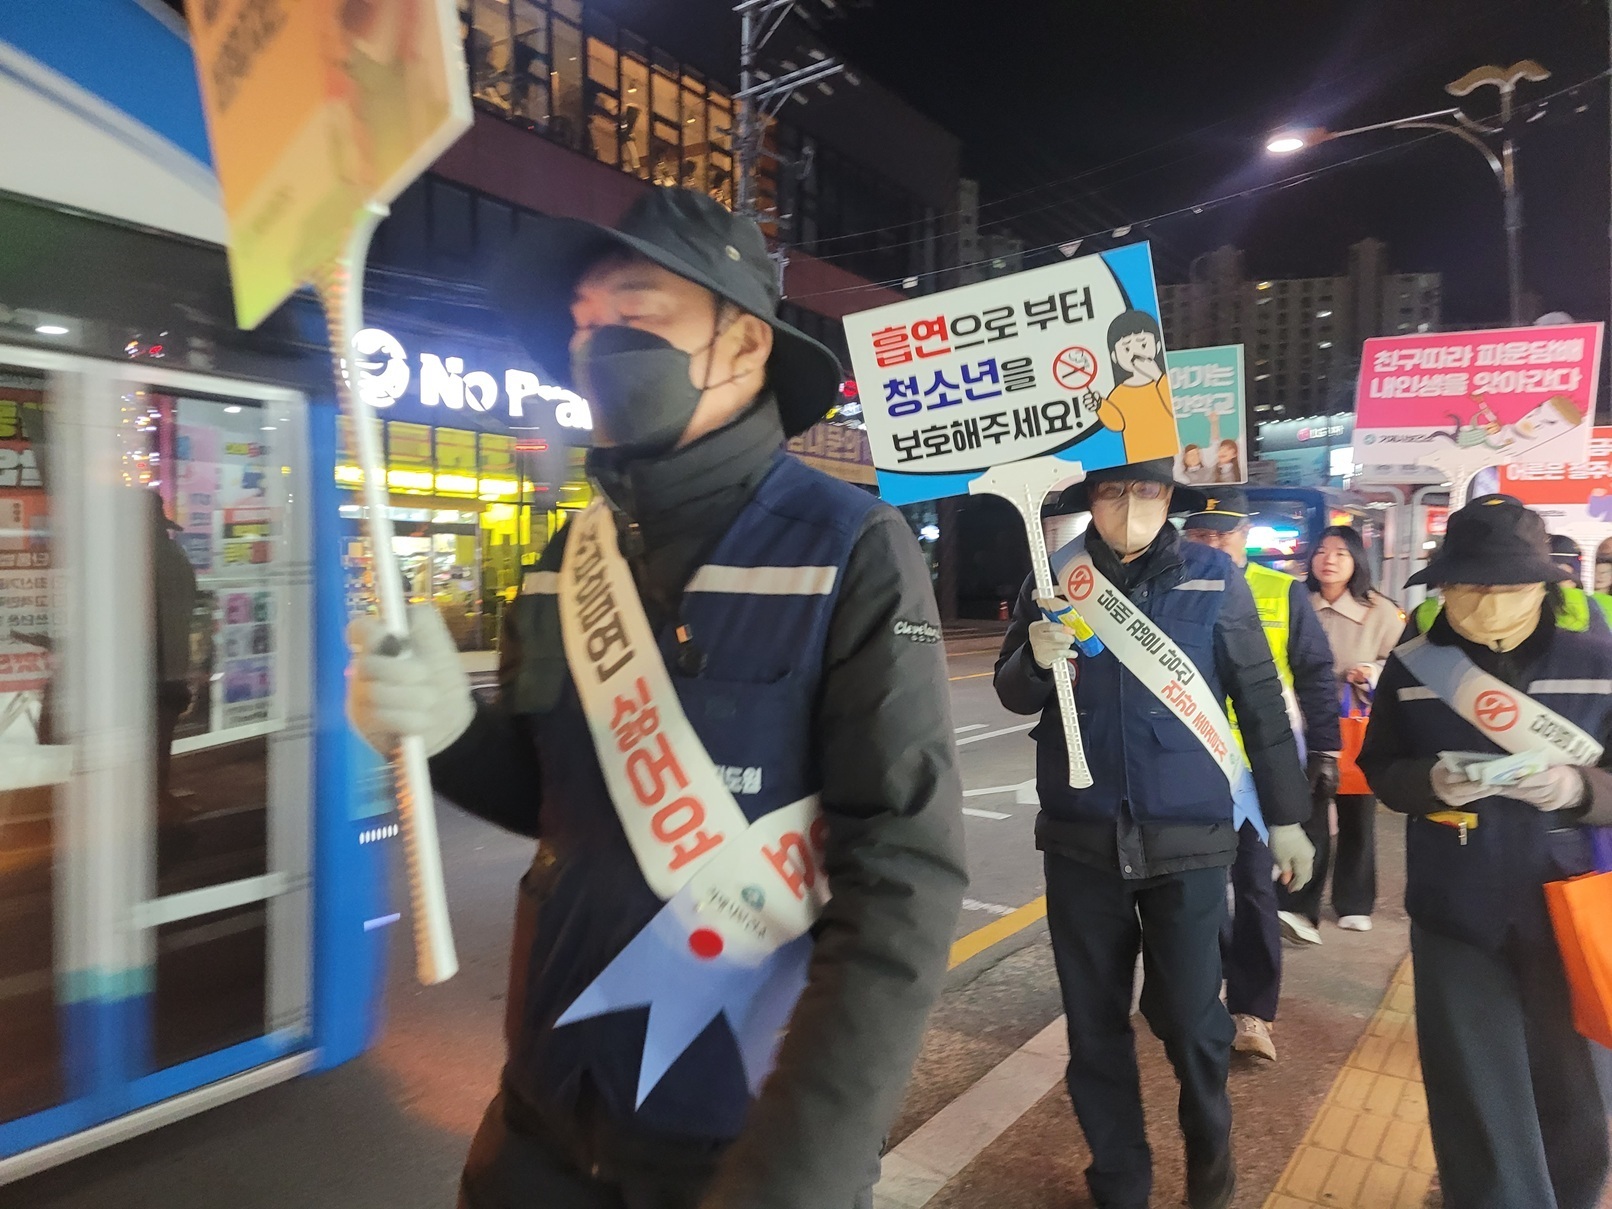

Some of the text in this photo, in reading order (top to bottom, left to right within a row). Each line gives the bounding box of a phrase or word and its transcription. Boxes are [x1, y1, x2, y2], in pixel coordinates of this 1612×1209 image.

[871, 286, 1095, 368] 흡연으로 부터
[420, 353, 498, 412] No
[882, 356, 1037, 418] 청소년을
[1369, 372, 1470, 398] 내인생을
[1373, 345, 1474, 372] 친구따라
[891, 396, 1085, 464] 보호해주세요!
[1096, 588, 1134, 625] 담배
[1158, 648, 1196, 686] 당신
[1161, 679, 1196, 718] 건강
